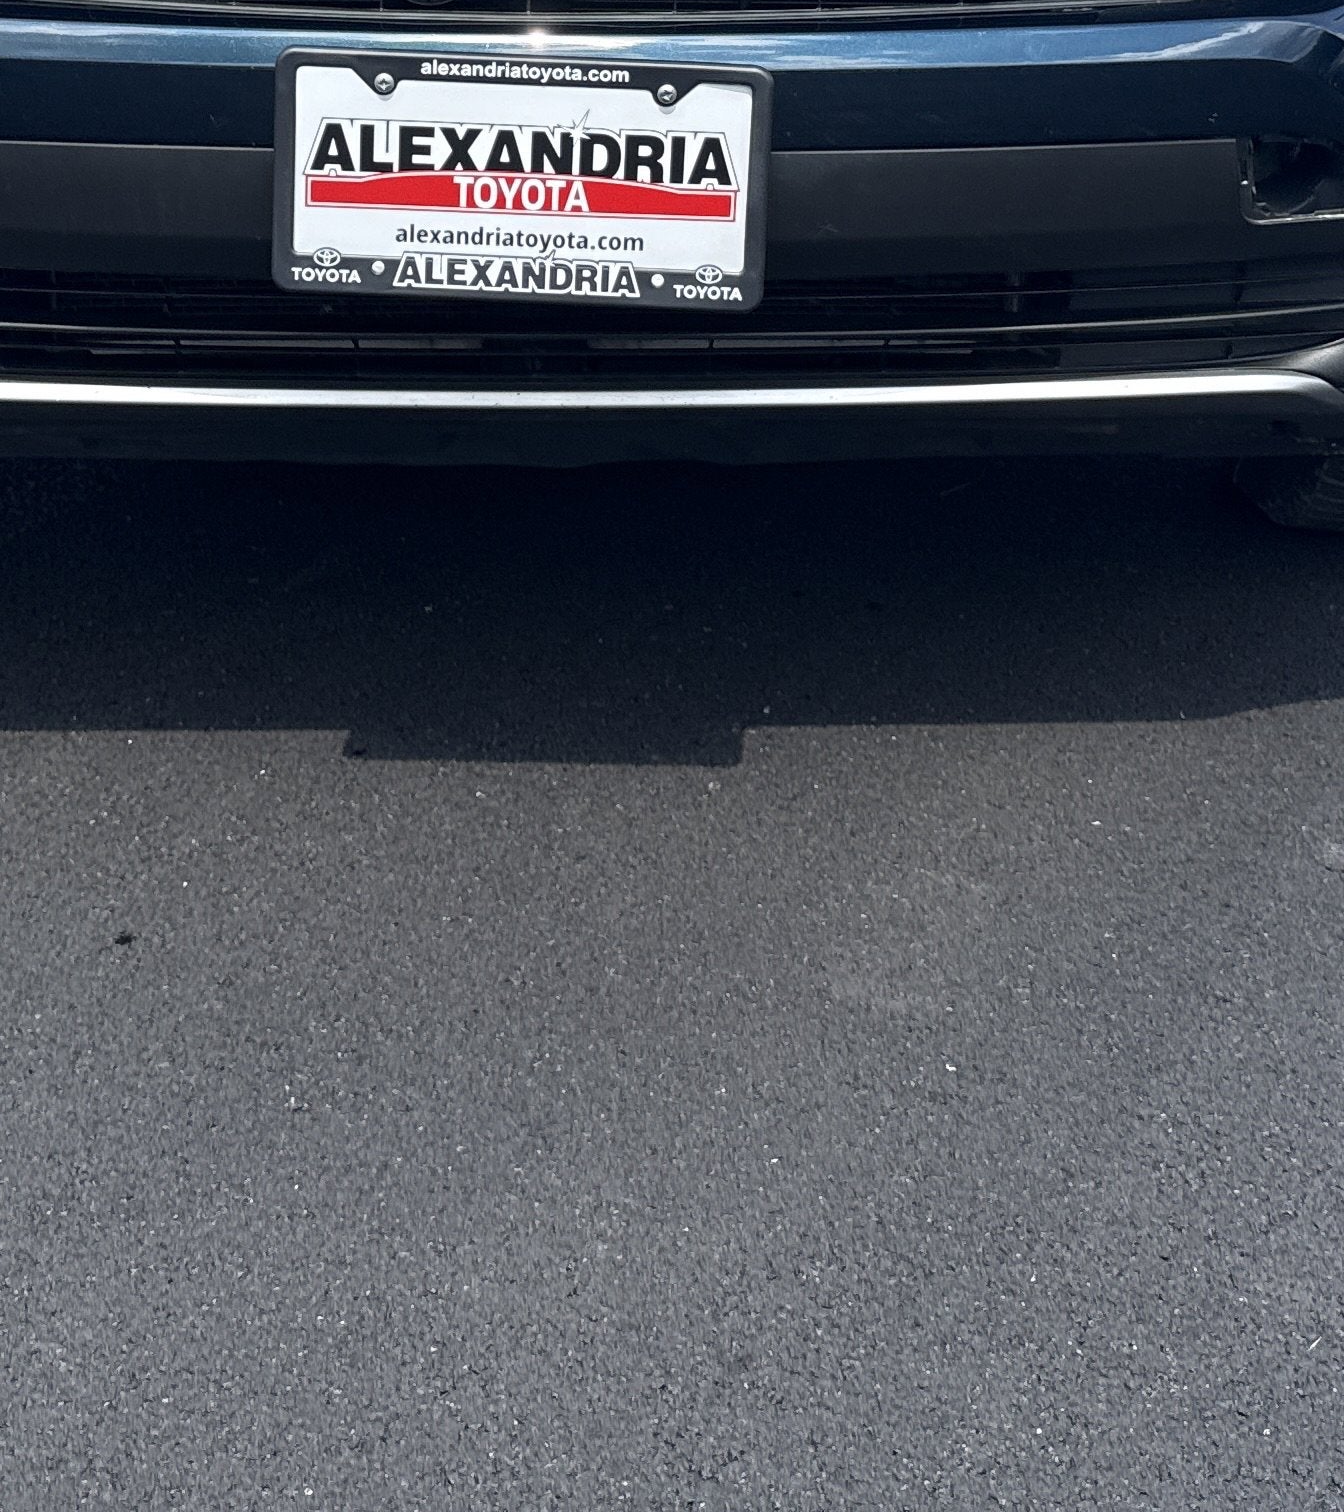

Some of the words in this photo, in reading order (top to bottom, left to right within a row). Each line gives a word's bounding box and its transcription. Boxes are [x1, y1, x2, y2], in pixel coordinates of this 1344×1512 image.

[420, 59, 630, 84] alexandriatoyota.com
[311, 123, 732, 186] ALEXANDRIA
[453, 177, 590, 213] TOYOTA
[395, 224, 645, 254] alexandriatoyota.com
[291, 267, 361, 285] TOYOTA
[394, 252, 640, 298] ALEXANDRIA
[673, 284, 744, 302] TOYOTA
